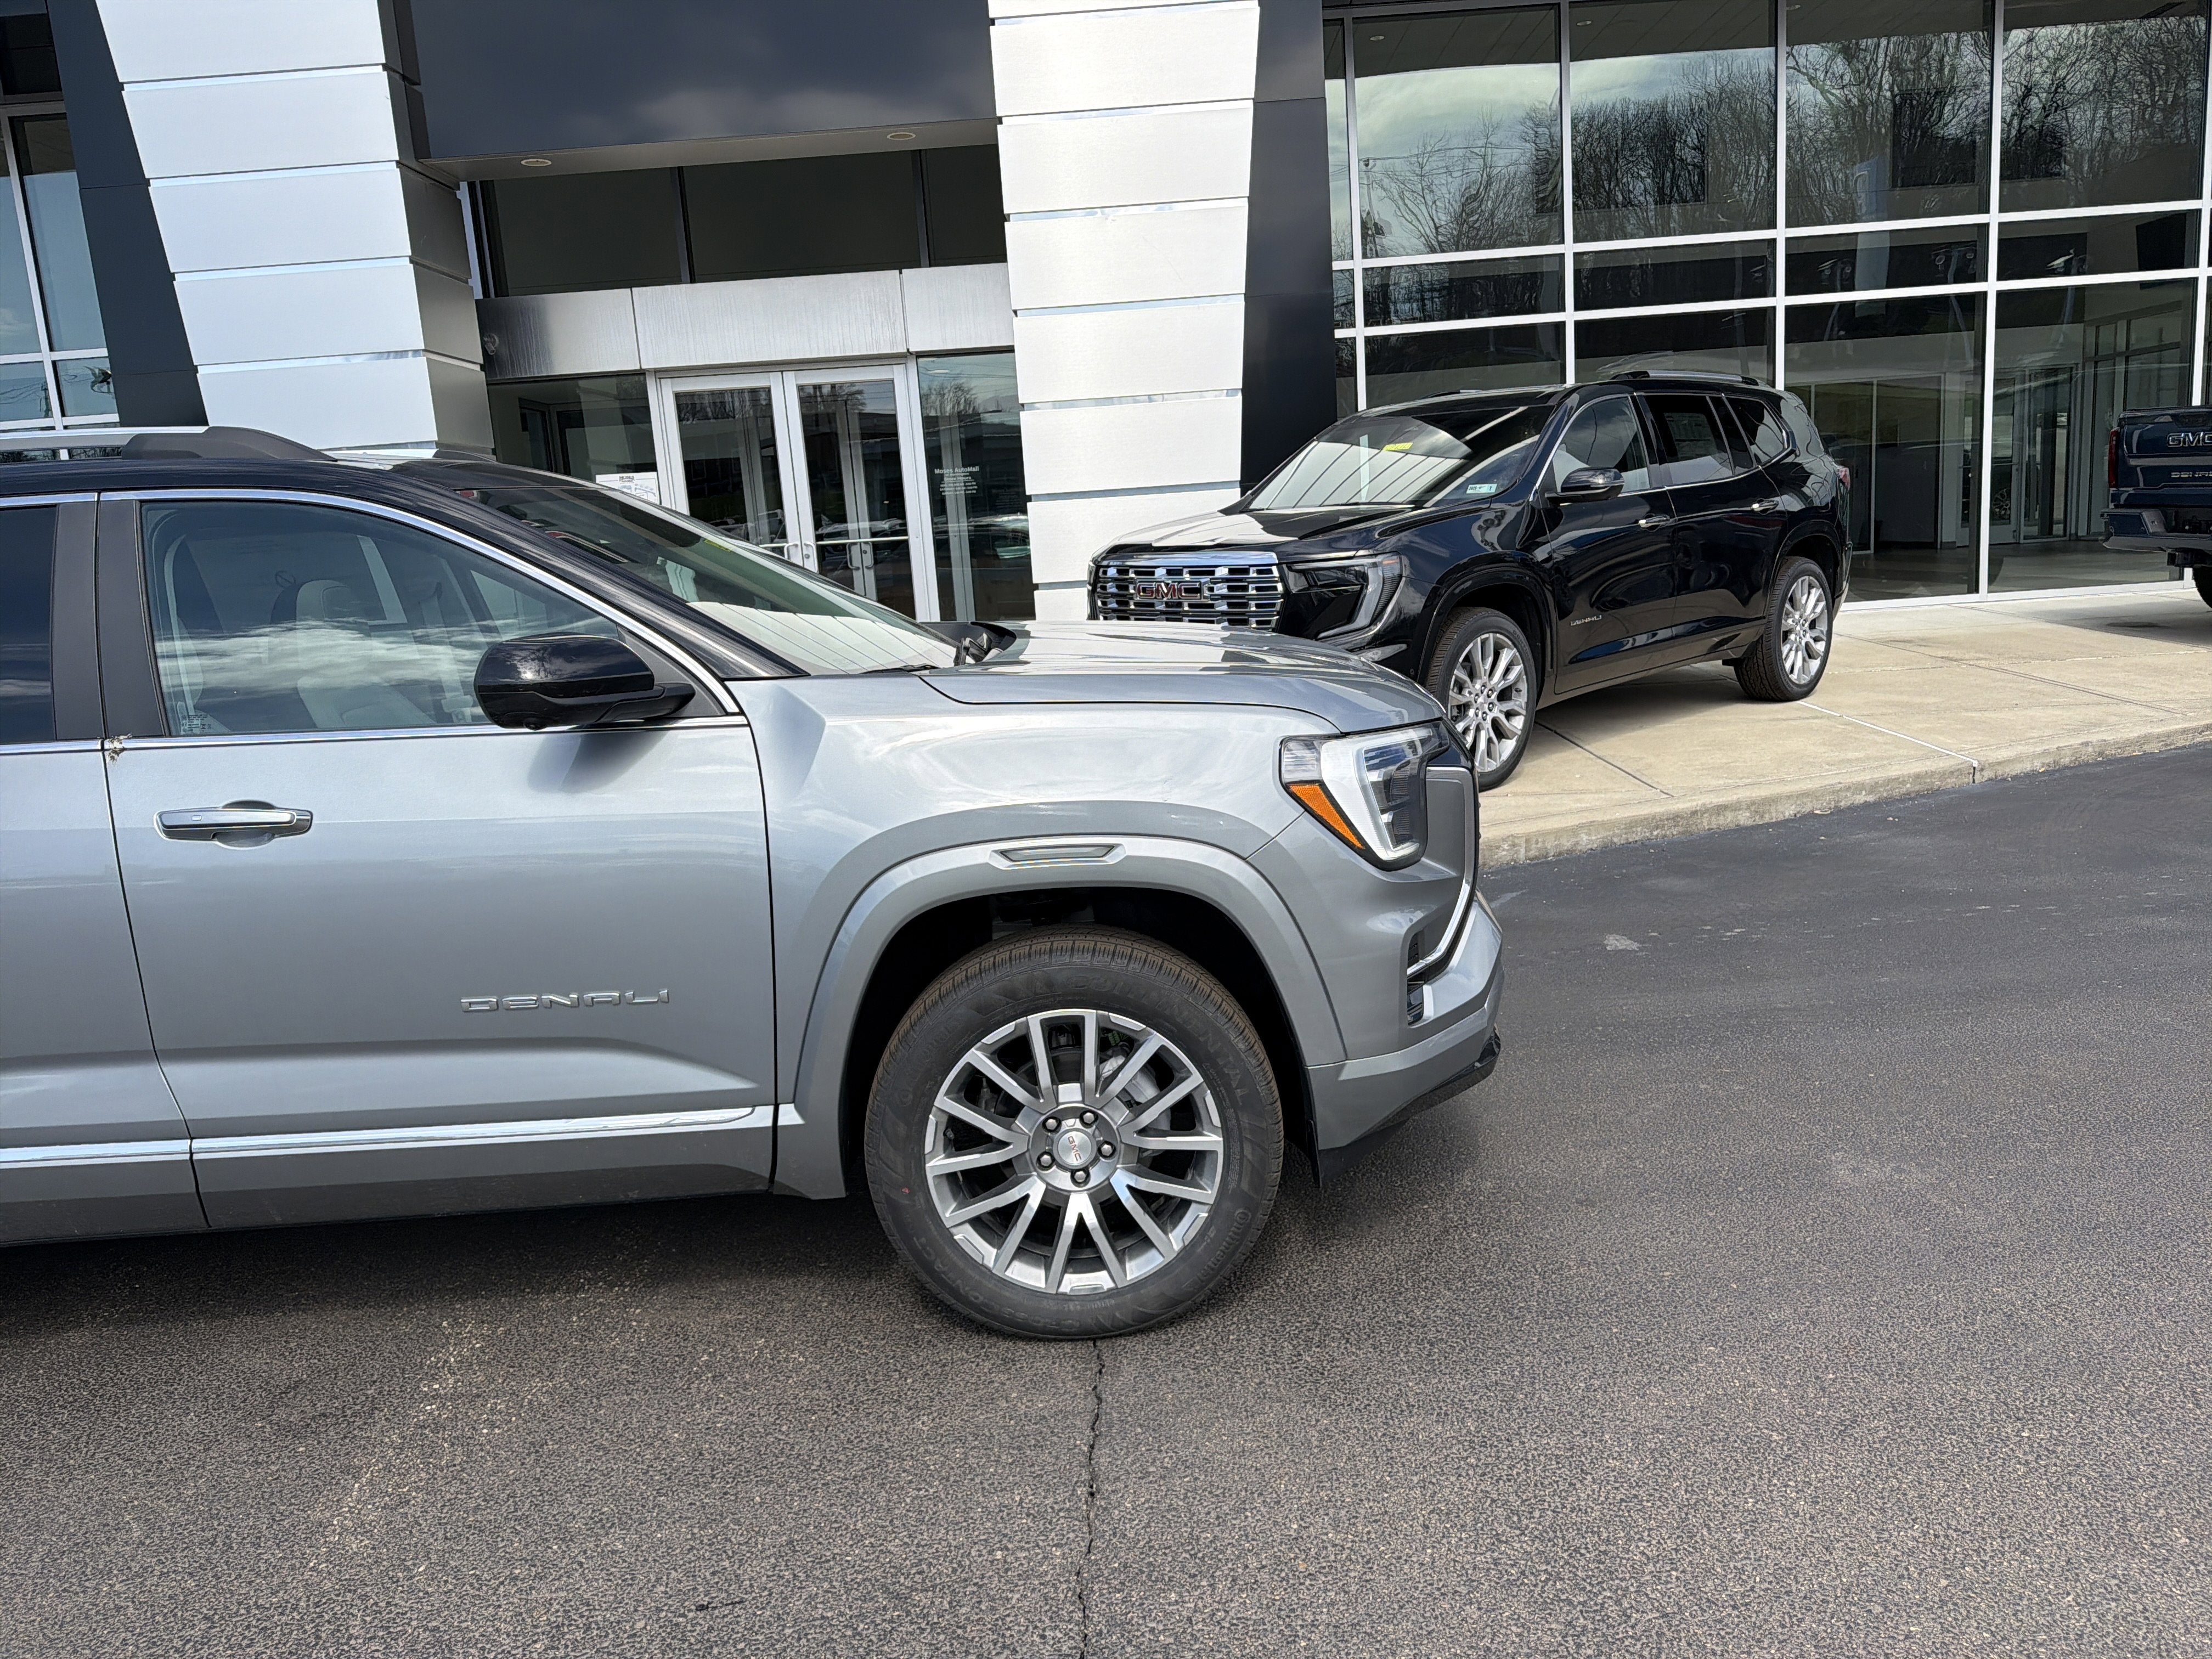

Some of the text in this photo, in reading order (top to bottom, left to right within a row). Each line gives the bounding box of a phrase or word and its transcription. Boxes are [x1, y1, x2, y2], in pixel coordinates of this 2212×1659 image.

[1137, 582, 1201, 600] GMC
[1570, 615, 1602, 626] DENALI
[460, 989, 670, 1012] DENALI
[1068, 1136, 1082, 1161] GMC
